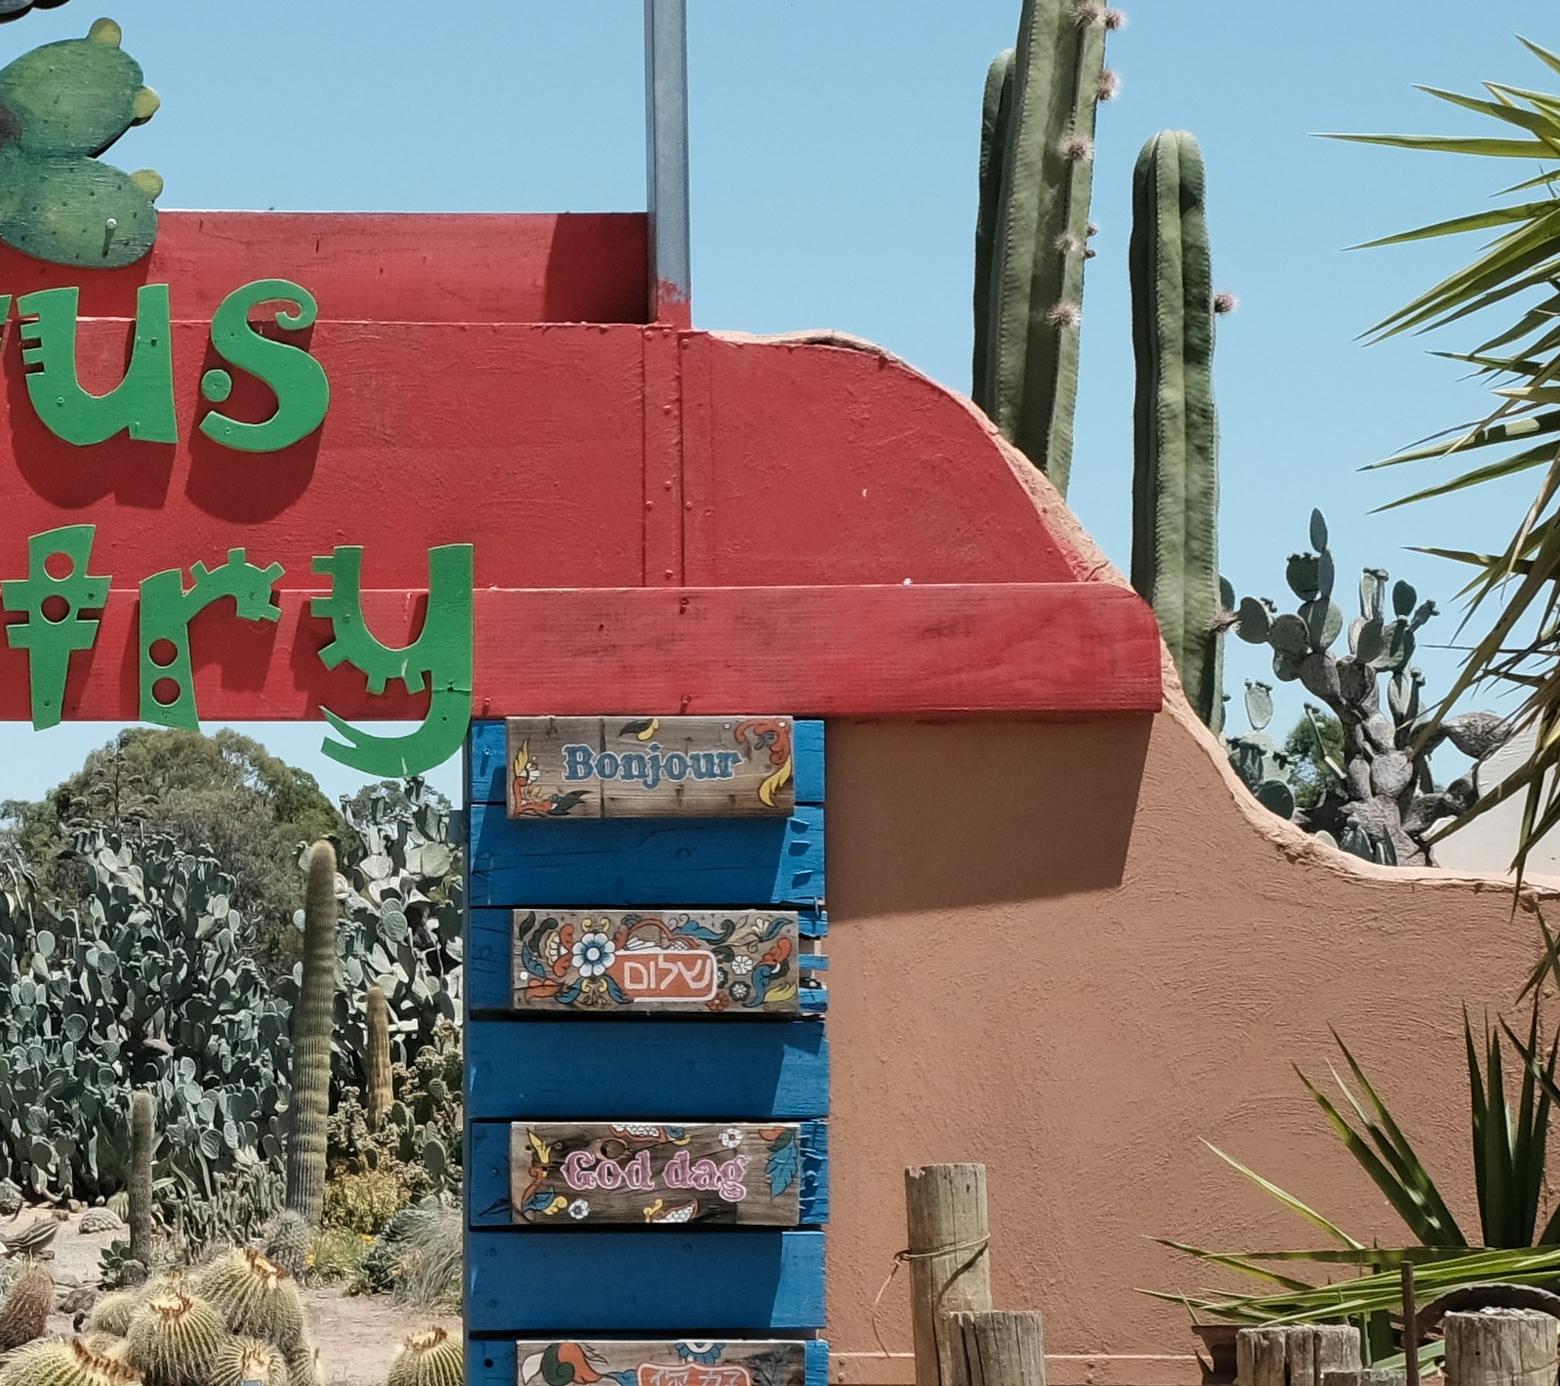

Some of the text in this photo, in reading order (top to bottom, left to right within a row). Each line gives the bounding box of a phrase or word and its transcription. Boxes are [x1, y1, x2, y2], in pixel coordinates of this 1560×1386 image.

[561, 742, 744, 790] Bonjour
[623, 954, 713, 991] שלום
[560, 1149, 752, 1204] God dag
